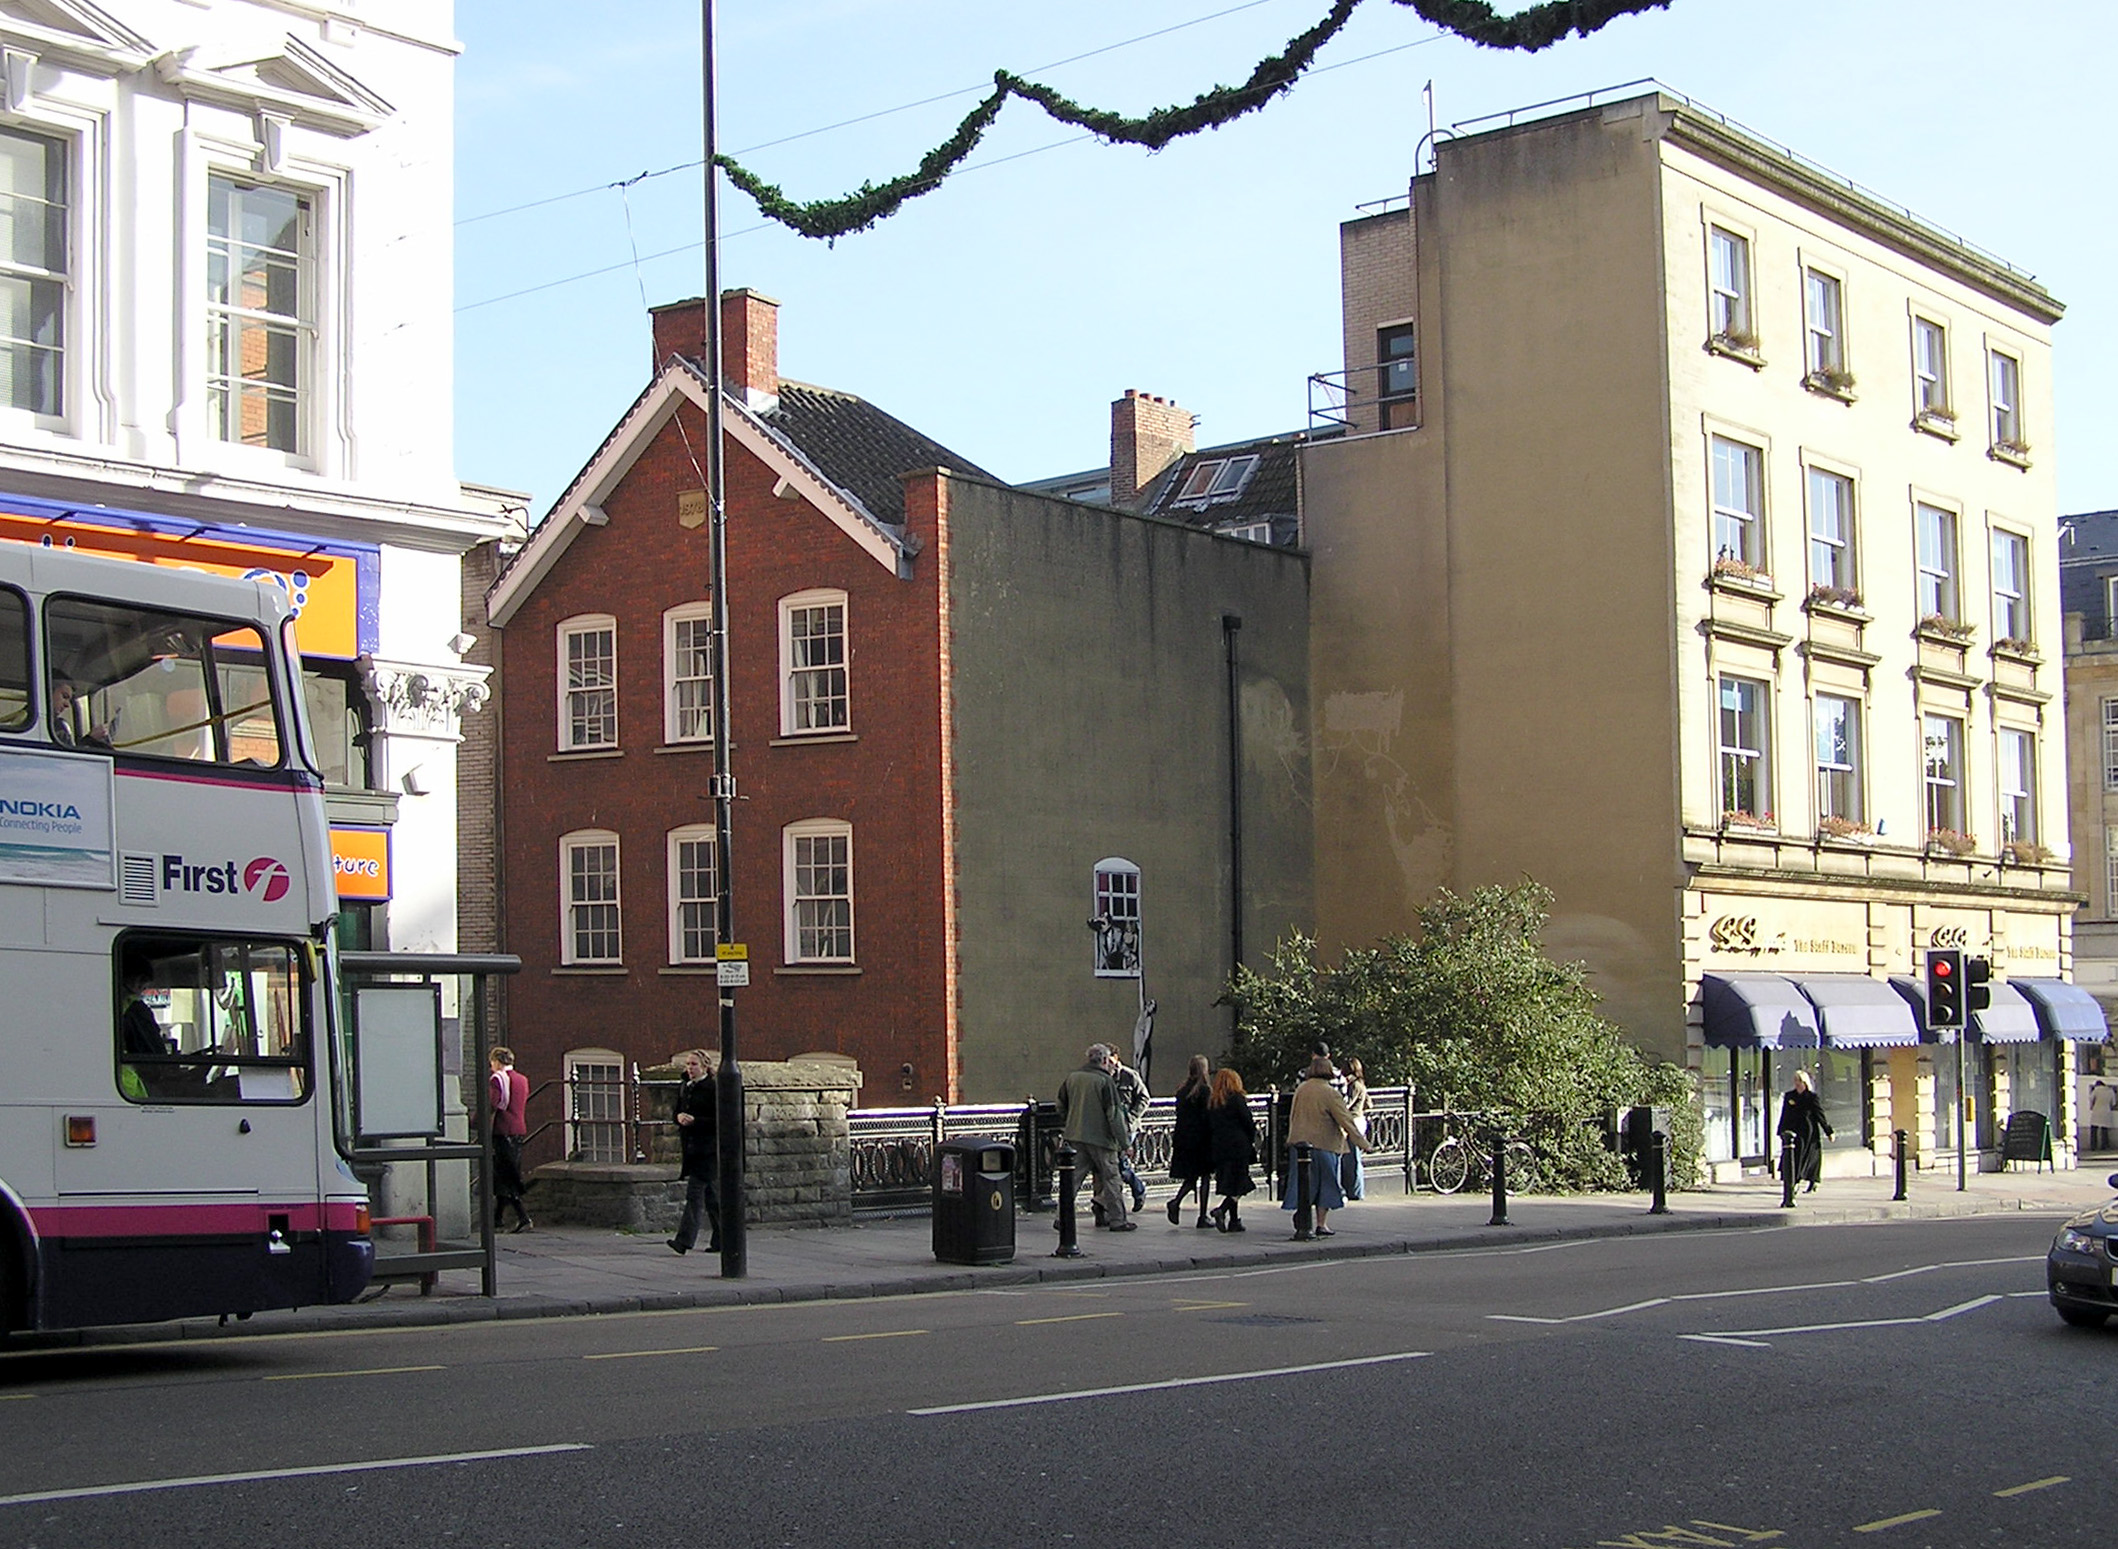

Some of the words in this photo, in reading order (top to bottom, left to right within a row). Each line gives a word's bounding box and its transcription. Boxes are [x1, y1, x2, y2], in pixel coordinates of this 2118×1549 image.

[0, 799, 81, 820] NOKIA
[0, 816, 51, 833] Connecting
[52, 820, 82, 834] People
[162, 854, 239, 895] First
